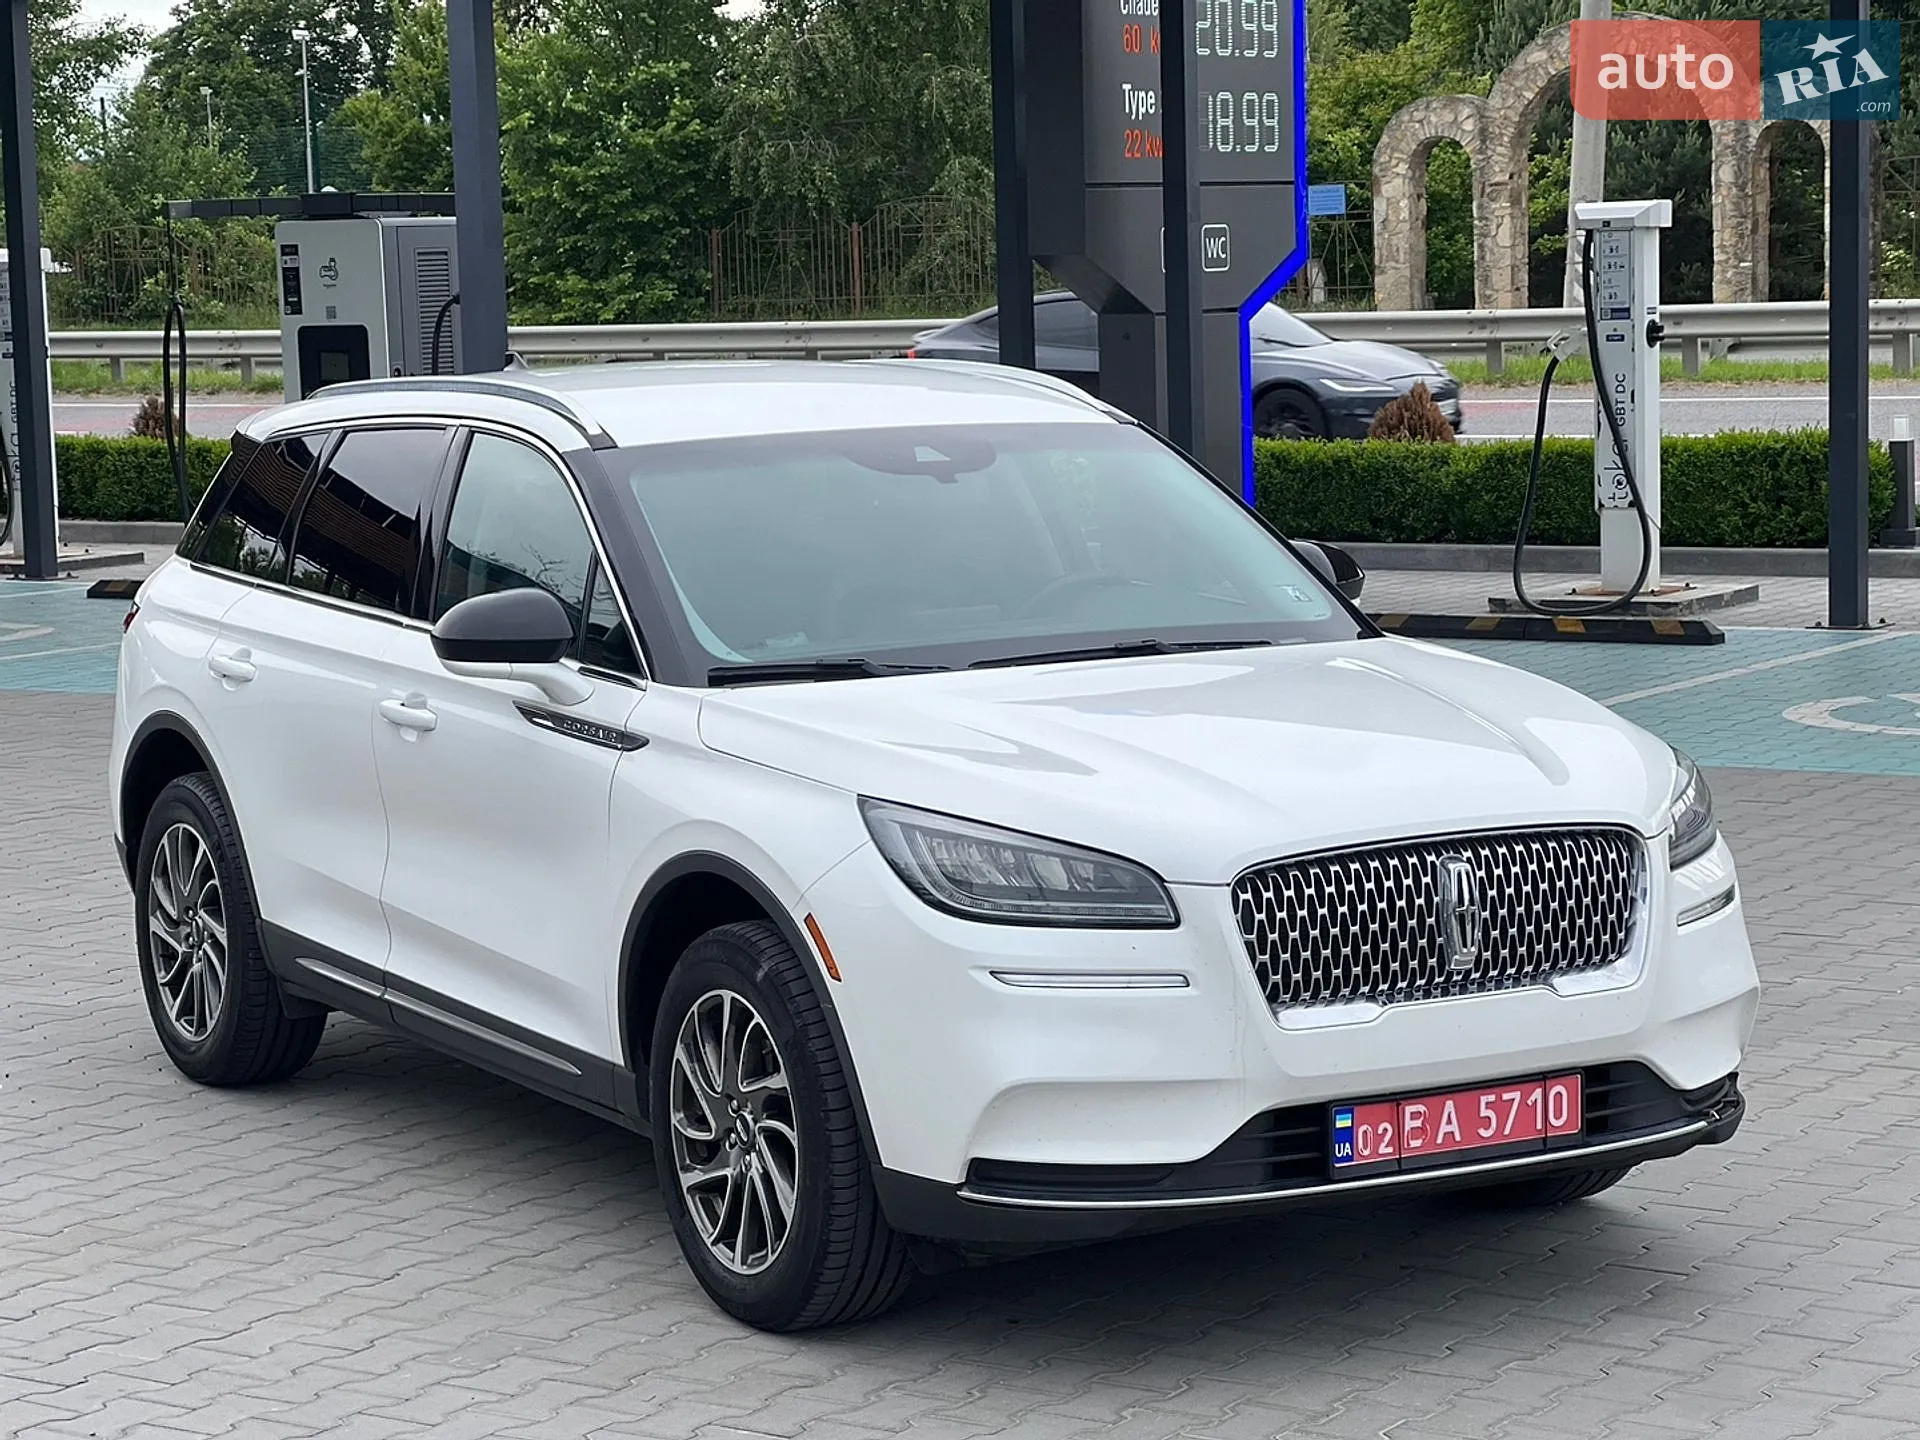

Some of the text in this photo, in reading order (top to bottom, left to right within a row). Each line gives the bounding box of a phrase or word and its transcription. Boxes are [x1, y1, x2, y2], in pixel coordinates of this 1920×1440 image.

[1123, 24, 1161, 54] 60 k
[1196, 0, 1279, 57] 20.99
[1122, 83, 1156, 120] Type
[1207, 91, 1280, 152] 18.99
[1124, 129, 1142, 158] 22
[1205, 238, 1226, 258] WC
[1614, 373, 1627, 394] DC
[1614, 398, 1627, 427] GBT
[564, 720, 616, 742] CORSAIR
[1357, 1084, 1569, 1156] 02 BA 5710
[1335, 1142, 1352, 1158] UA
